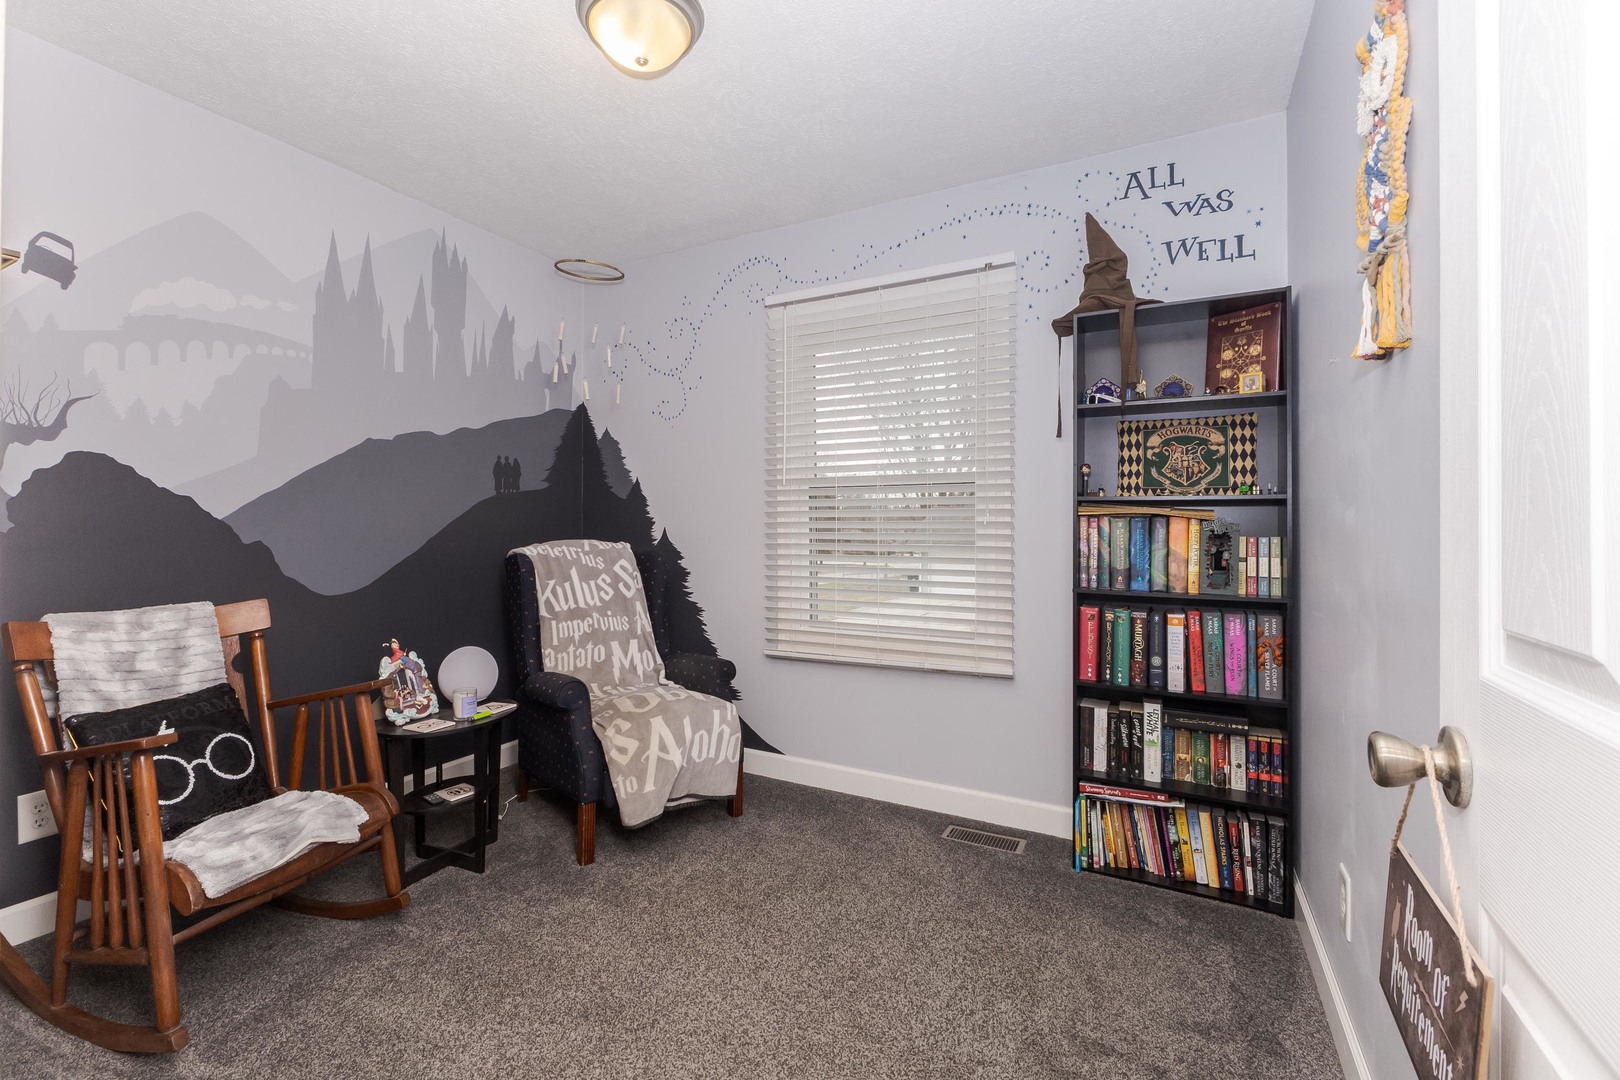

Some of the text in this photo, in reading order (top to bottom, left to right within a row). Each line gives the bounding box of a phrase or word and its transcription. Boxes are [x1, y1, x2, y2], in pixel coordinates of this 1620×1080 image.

[1119, 162, 1185, 201] ALL
[1161, 188, 1235, 217] WAS
[1161, 234, 1256, 265] WELL
[1156, 426, 1212, 440] HOGWARTS
[551, 610, 630, 646] Impervius
[1134, 624, 1142, 662] MURTAGH
[1217, 817, 1225, 845] NICHOLAS
[1233, 862, 1241, 881] RISING
[1403, 883, 1434, 973] Room
